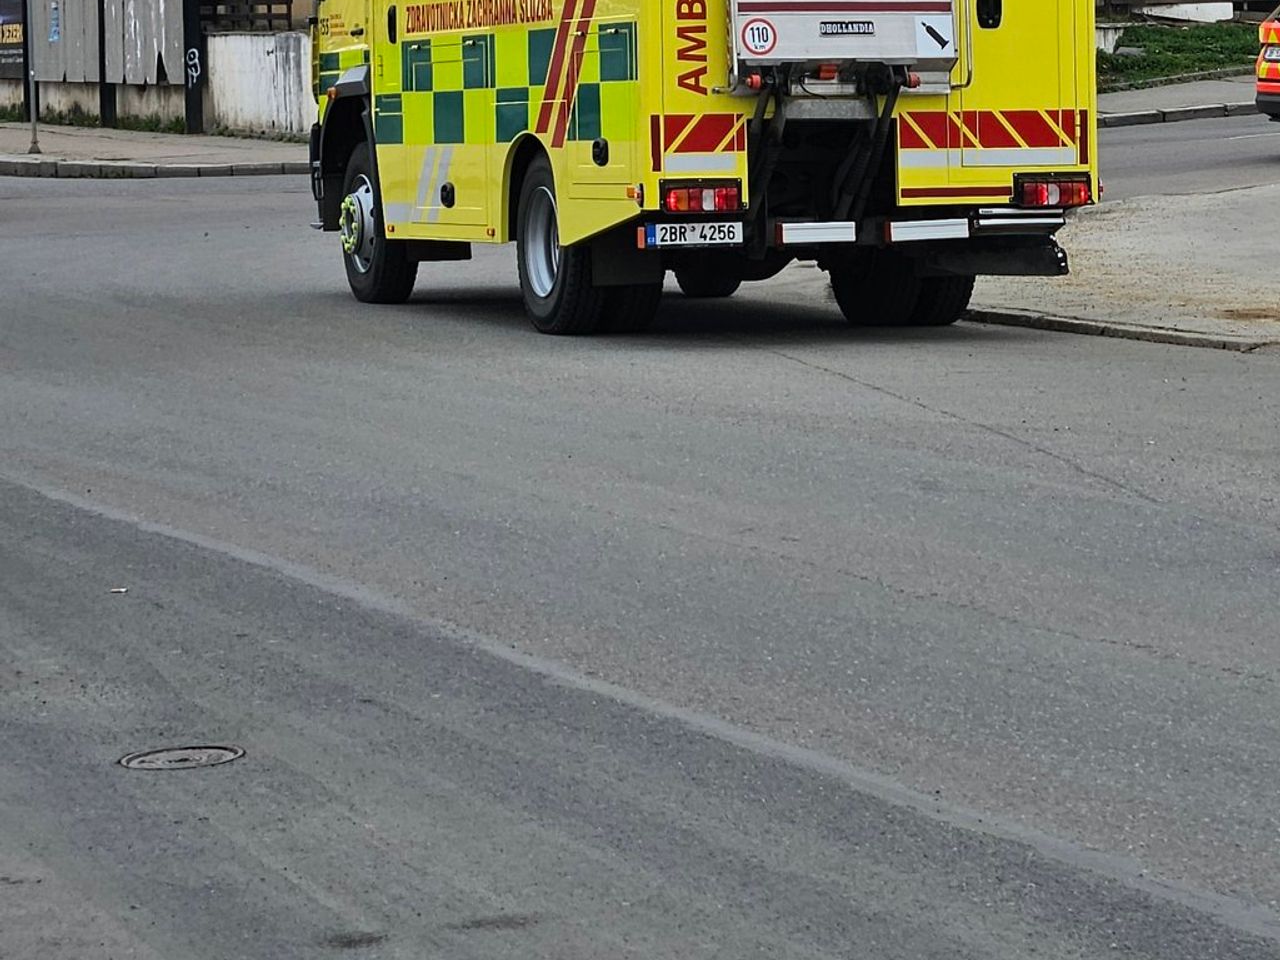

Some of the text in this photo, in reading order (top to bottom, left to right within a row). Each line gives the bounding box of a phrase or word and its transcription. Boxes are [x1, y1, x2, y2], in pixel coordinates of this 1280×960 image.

[749, 26, 769, 43] 110
[820, 22, 875, 34] DHOLLANDIA
[660, 225, 735, 243] 2BR 4256
